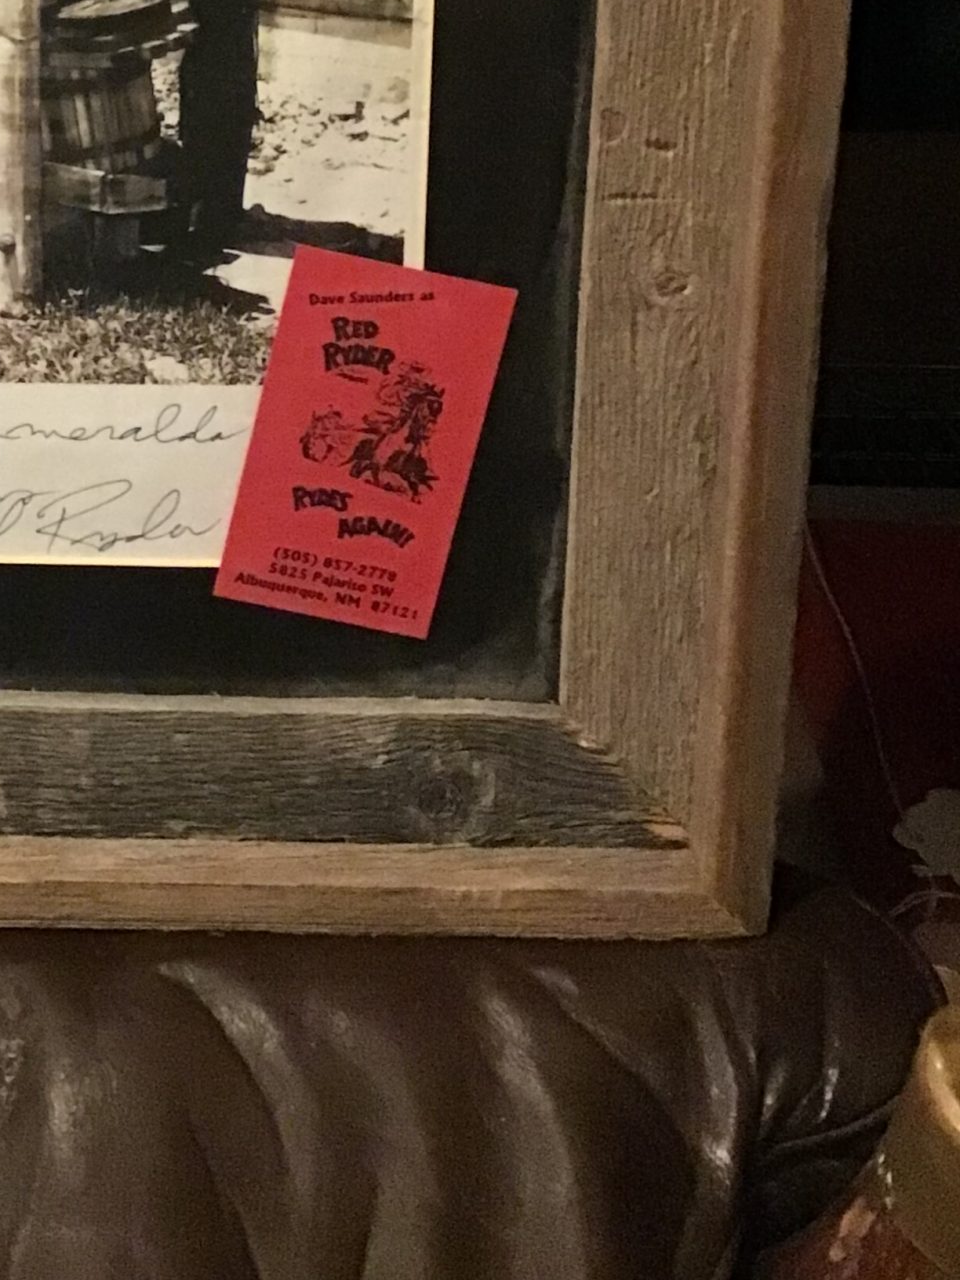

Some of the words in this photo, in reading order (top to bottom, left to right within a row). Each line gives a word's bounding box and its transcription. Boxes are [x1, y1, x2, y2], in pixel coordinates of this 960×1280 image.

[309, 293, 344, 306] Dave
[349, 291, 414, 304] Saunders
[420, 292, 435, 302] as
[330, 316, 380, 342] RED
[322, 342, 396, 375] RYDER
[35, 479, 222, 553] Ryder
[273, 547, 318, 567] (505)
[335, 592, 361, 609] NM
[371, 583, 395, 598] SW
